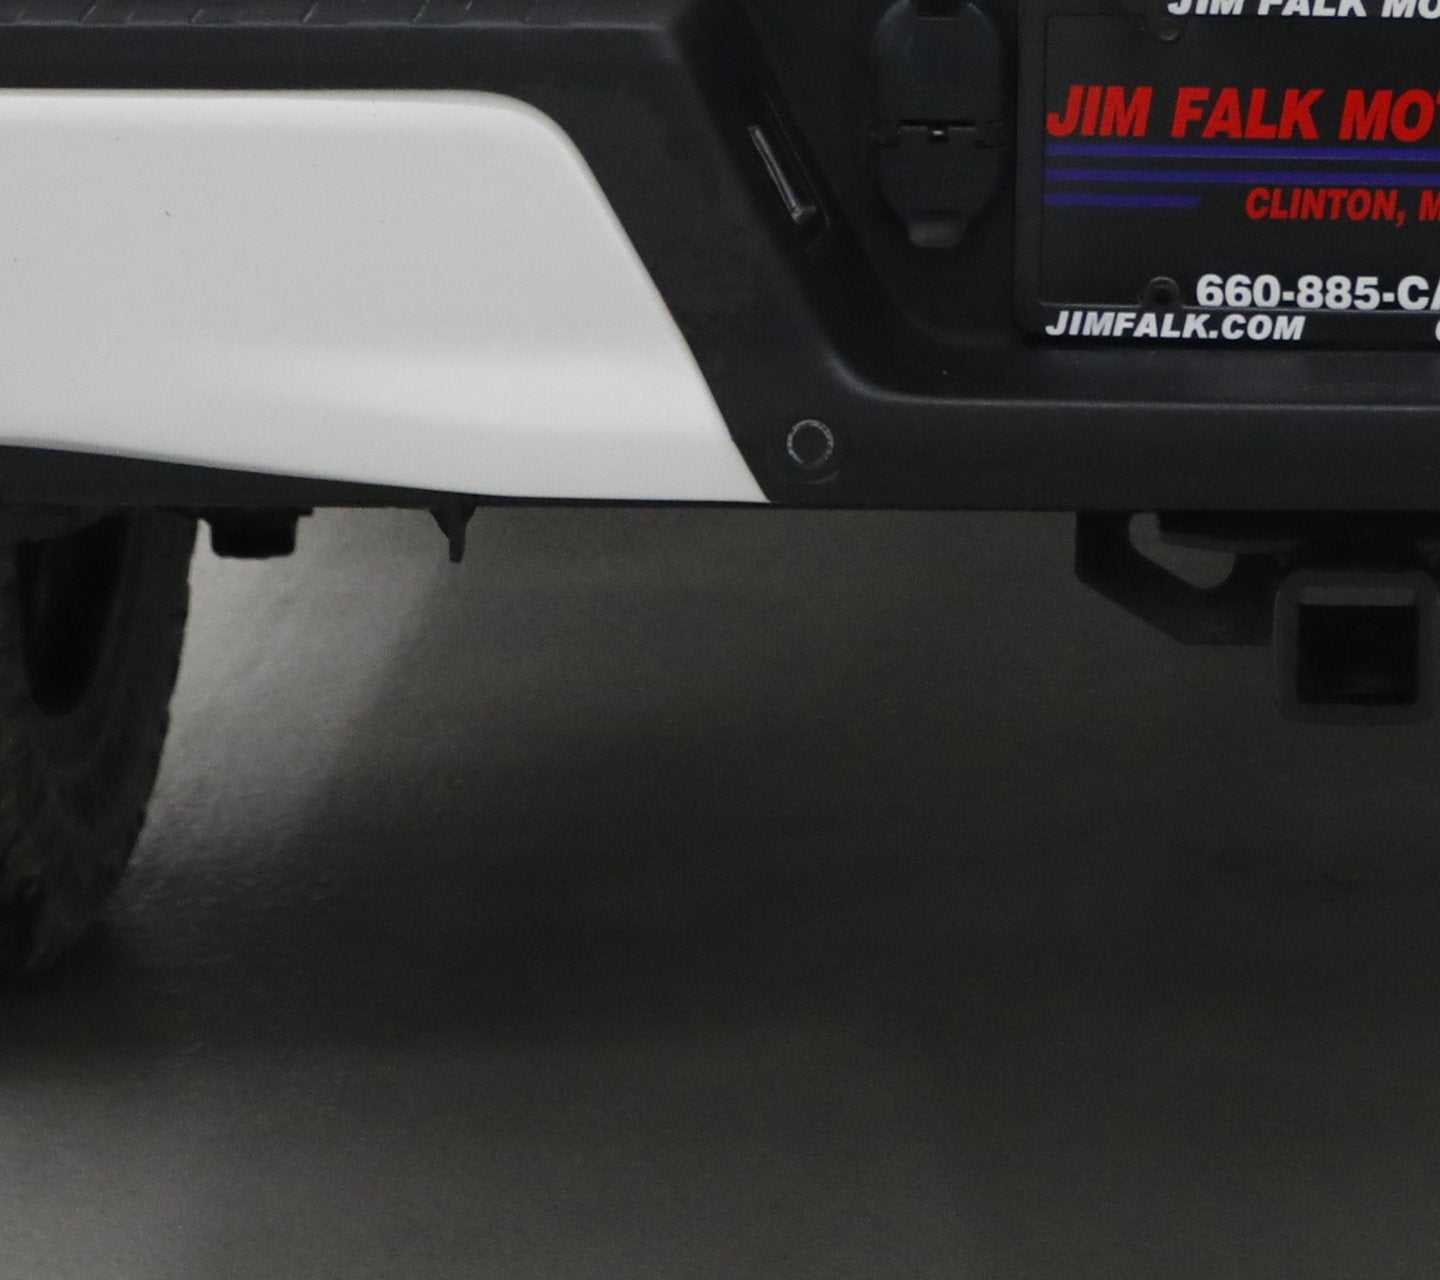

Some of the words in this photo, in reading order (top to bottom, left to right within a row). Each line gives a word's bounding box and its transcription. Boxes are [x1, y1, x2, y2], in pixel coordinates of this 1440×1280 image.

[1046, 85, 1153, 137] JIM
[1171, 86, 1324, 140] FALK
[1245, 187, 1406, 227] CLINTON,
[1045, 311, 1305, 341] JIMFALK.COM
